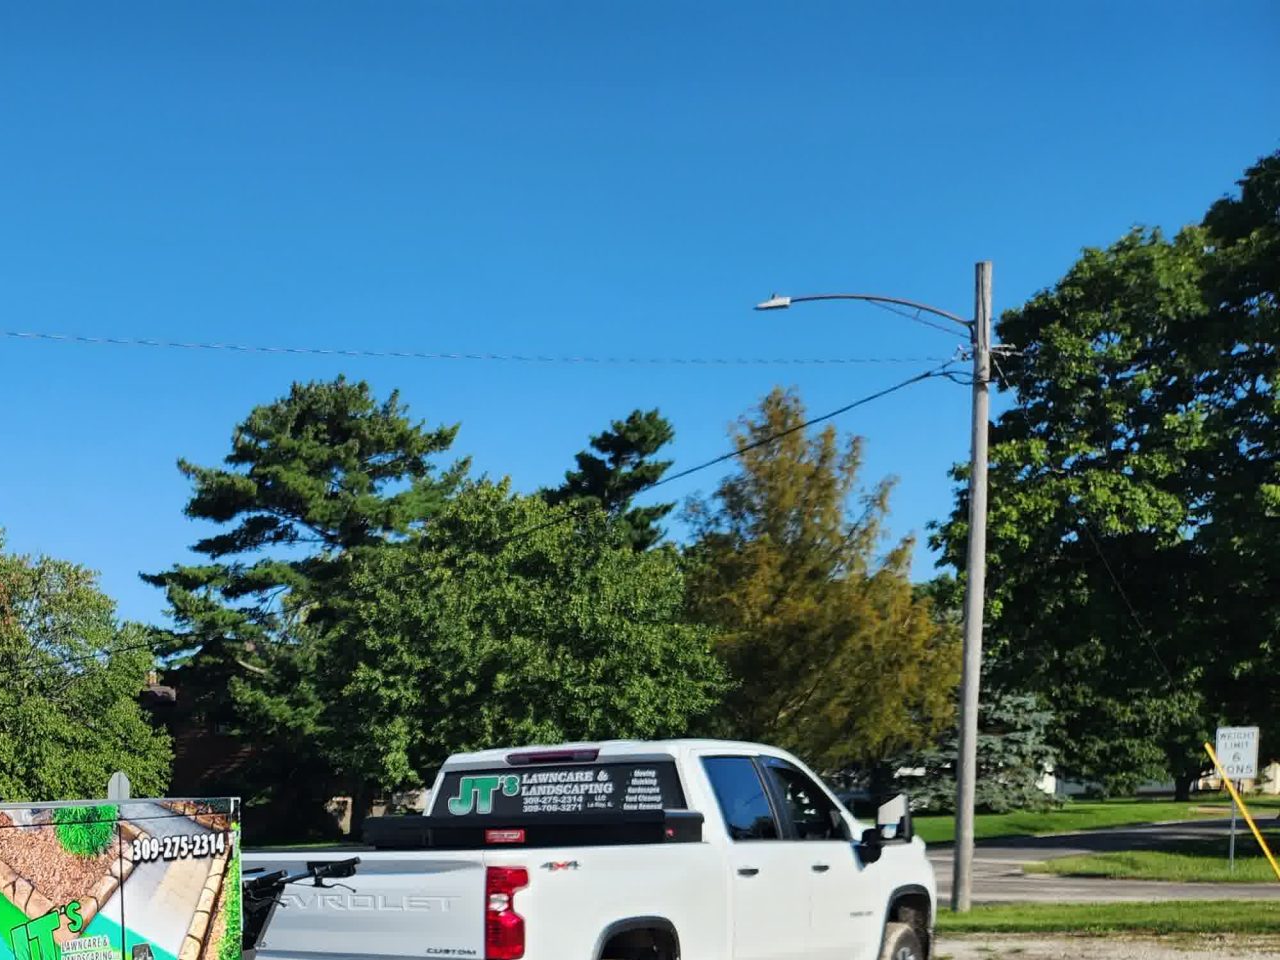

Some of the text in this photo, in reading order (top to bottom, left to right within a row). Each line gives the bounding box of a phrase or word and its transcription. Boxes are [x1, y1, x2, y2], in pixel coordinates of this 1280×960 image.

[1224, 741, 1248, 749] LIMIT
[522, 770, 609, 784] LAWNCARE &
[521, 783, 614, 796] LANDSCAPING
[523, 795, 583, 804] 309-275-2314
[132, 832, 226, 861] 309-275-2314
[62, 936, 108, 952] LAWNCARE &
[426, 947, 477, 956] CUSTOM
